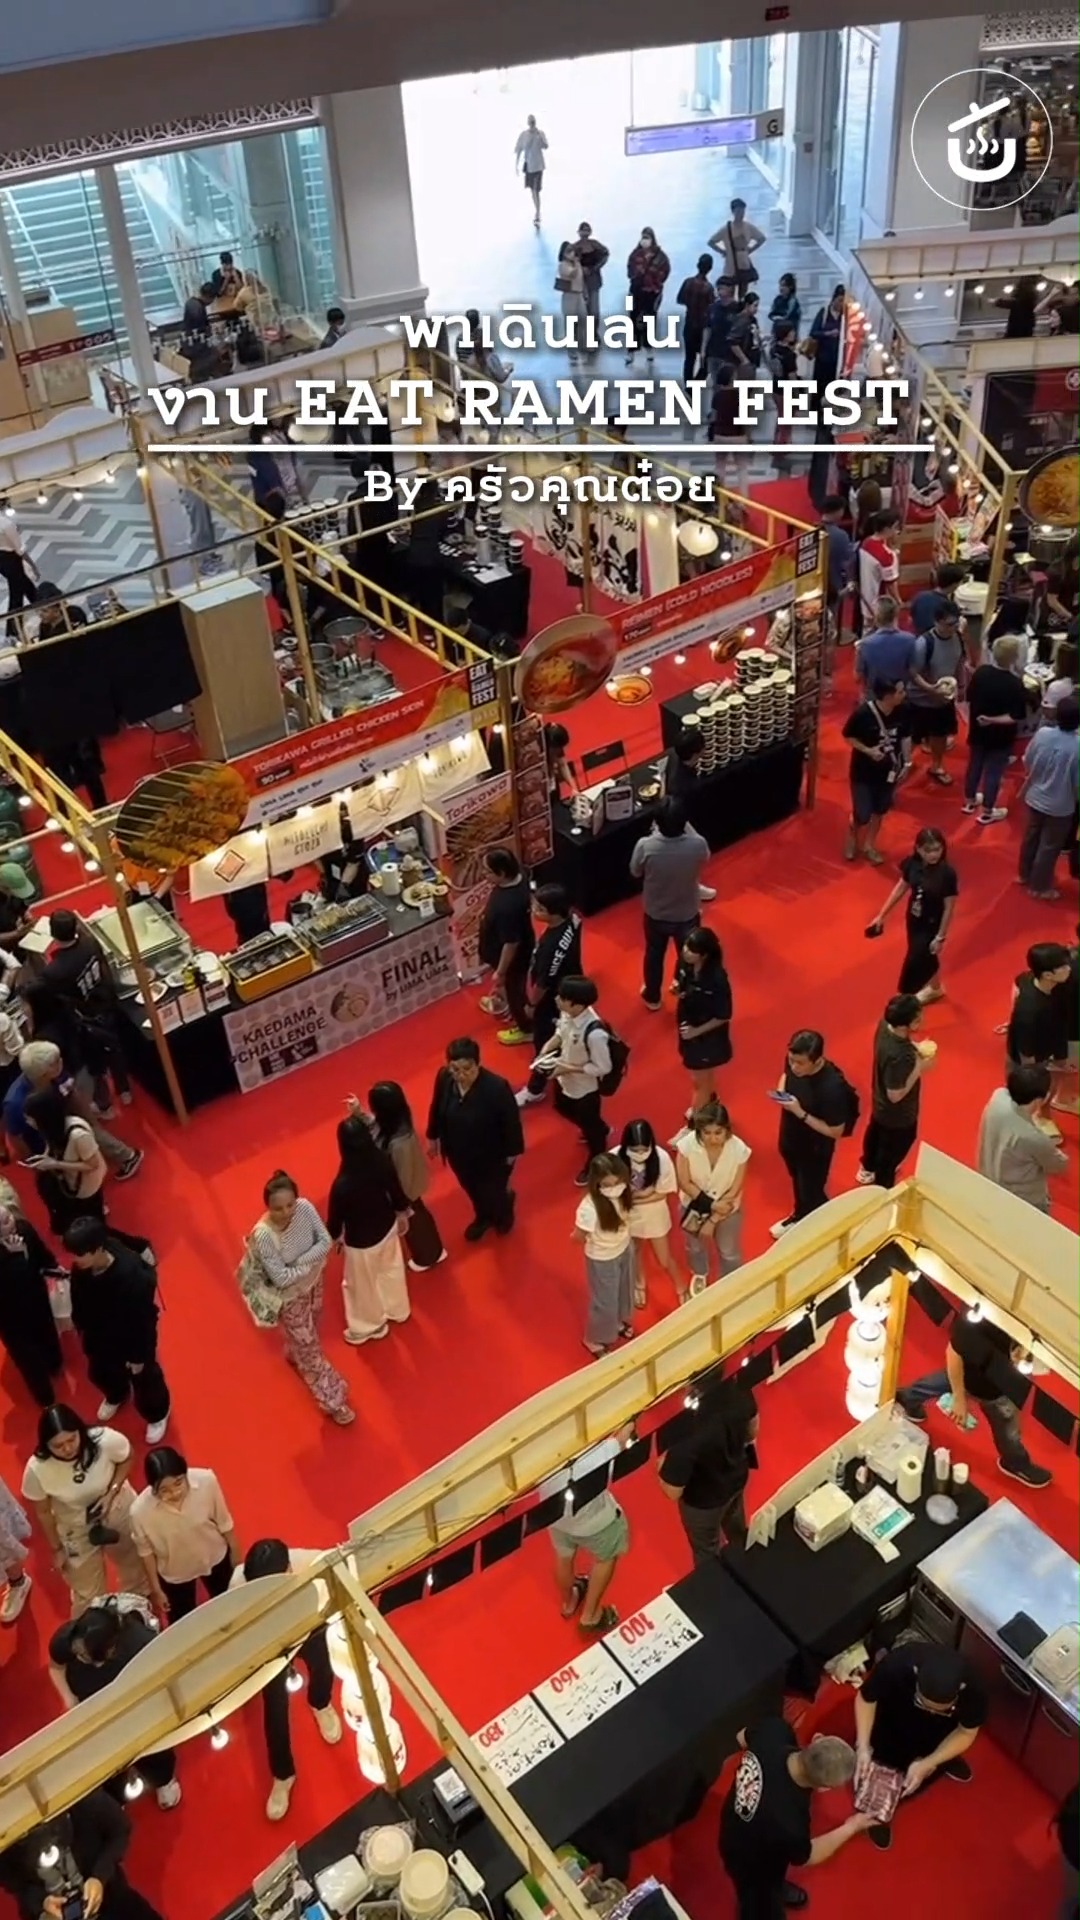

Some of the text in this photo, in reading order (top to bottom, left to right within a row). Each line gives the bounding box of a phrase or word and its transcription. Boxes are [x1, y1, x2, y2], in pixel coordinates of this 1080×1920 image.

[766, 119, 779, 134] G
[469, 662, 487, 680] EAT
[472, 686, 495, 706] FEST
[311, 727, 354, 749] GRILLED
[356, 709, 399, 732] CHICKEN
[401, 699, 424, 716] SKIN
[446, 780, 508, 821] Torikawa
[559, 925, 574, 950] GUY
[381, 945, 447, 988] FINAL
[386, 989, 398, 1001] by
[243, 1006, 316, 1045] KAEDAMA
[238, 1016, 327, 1064] CHALLENGE
[619, 1612, 655, 1645] 100
[550, 1666, 580, 1693] 160
[478, 1722, 504, 1748] 180
